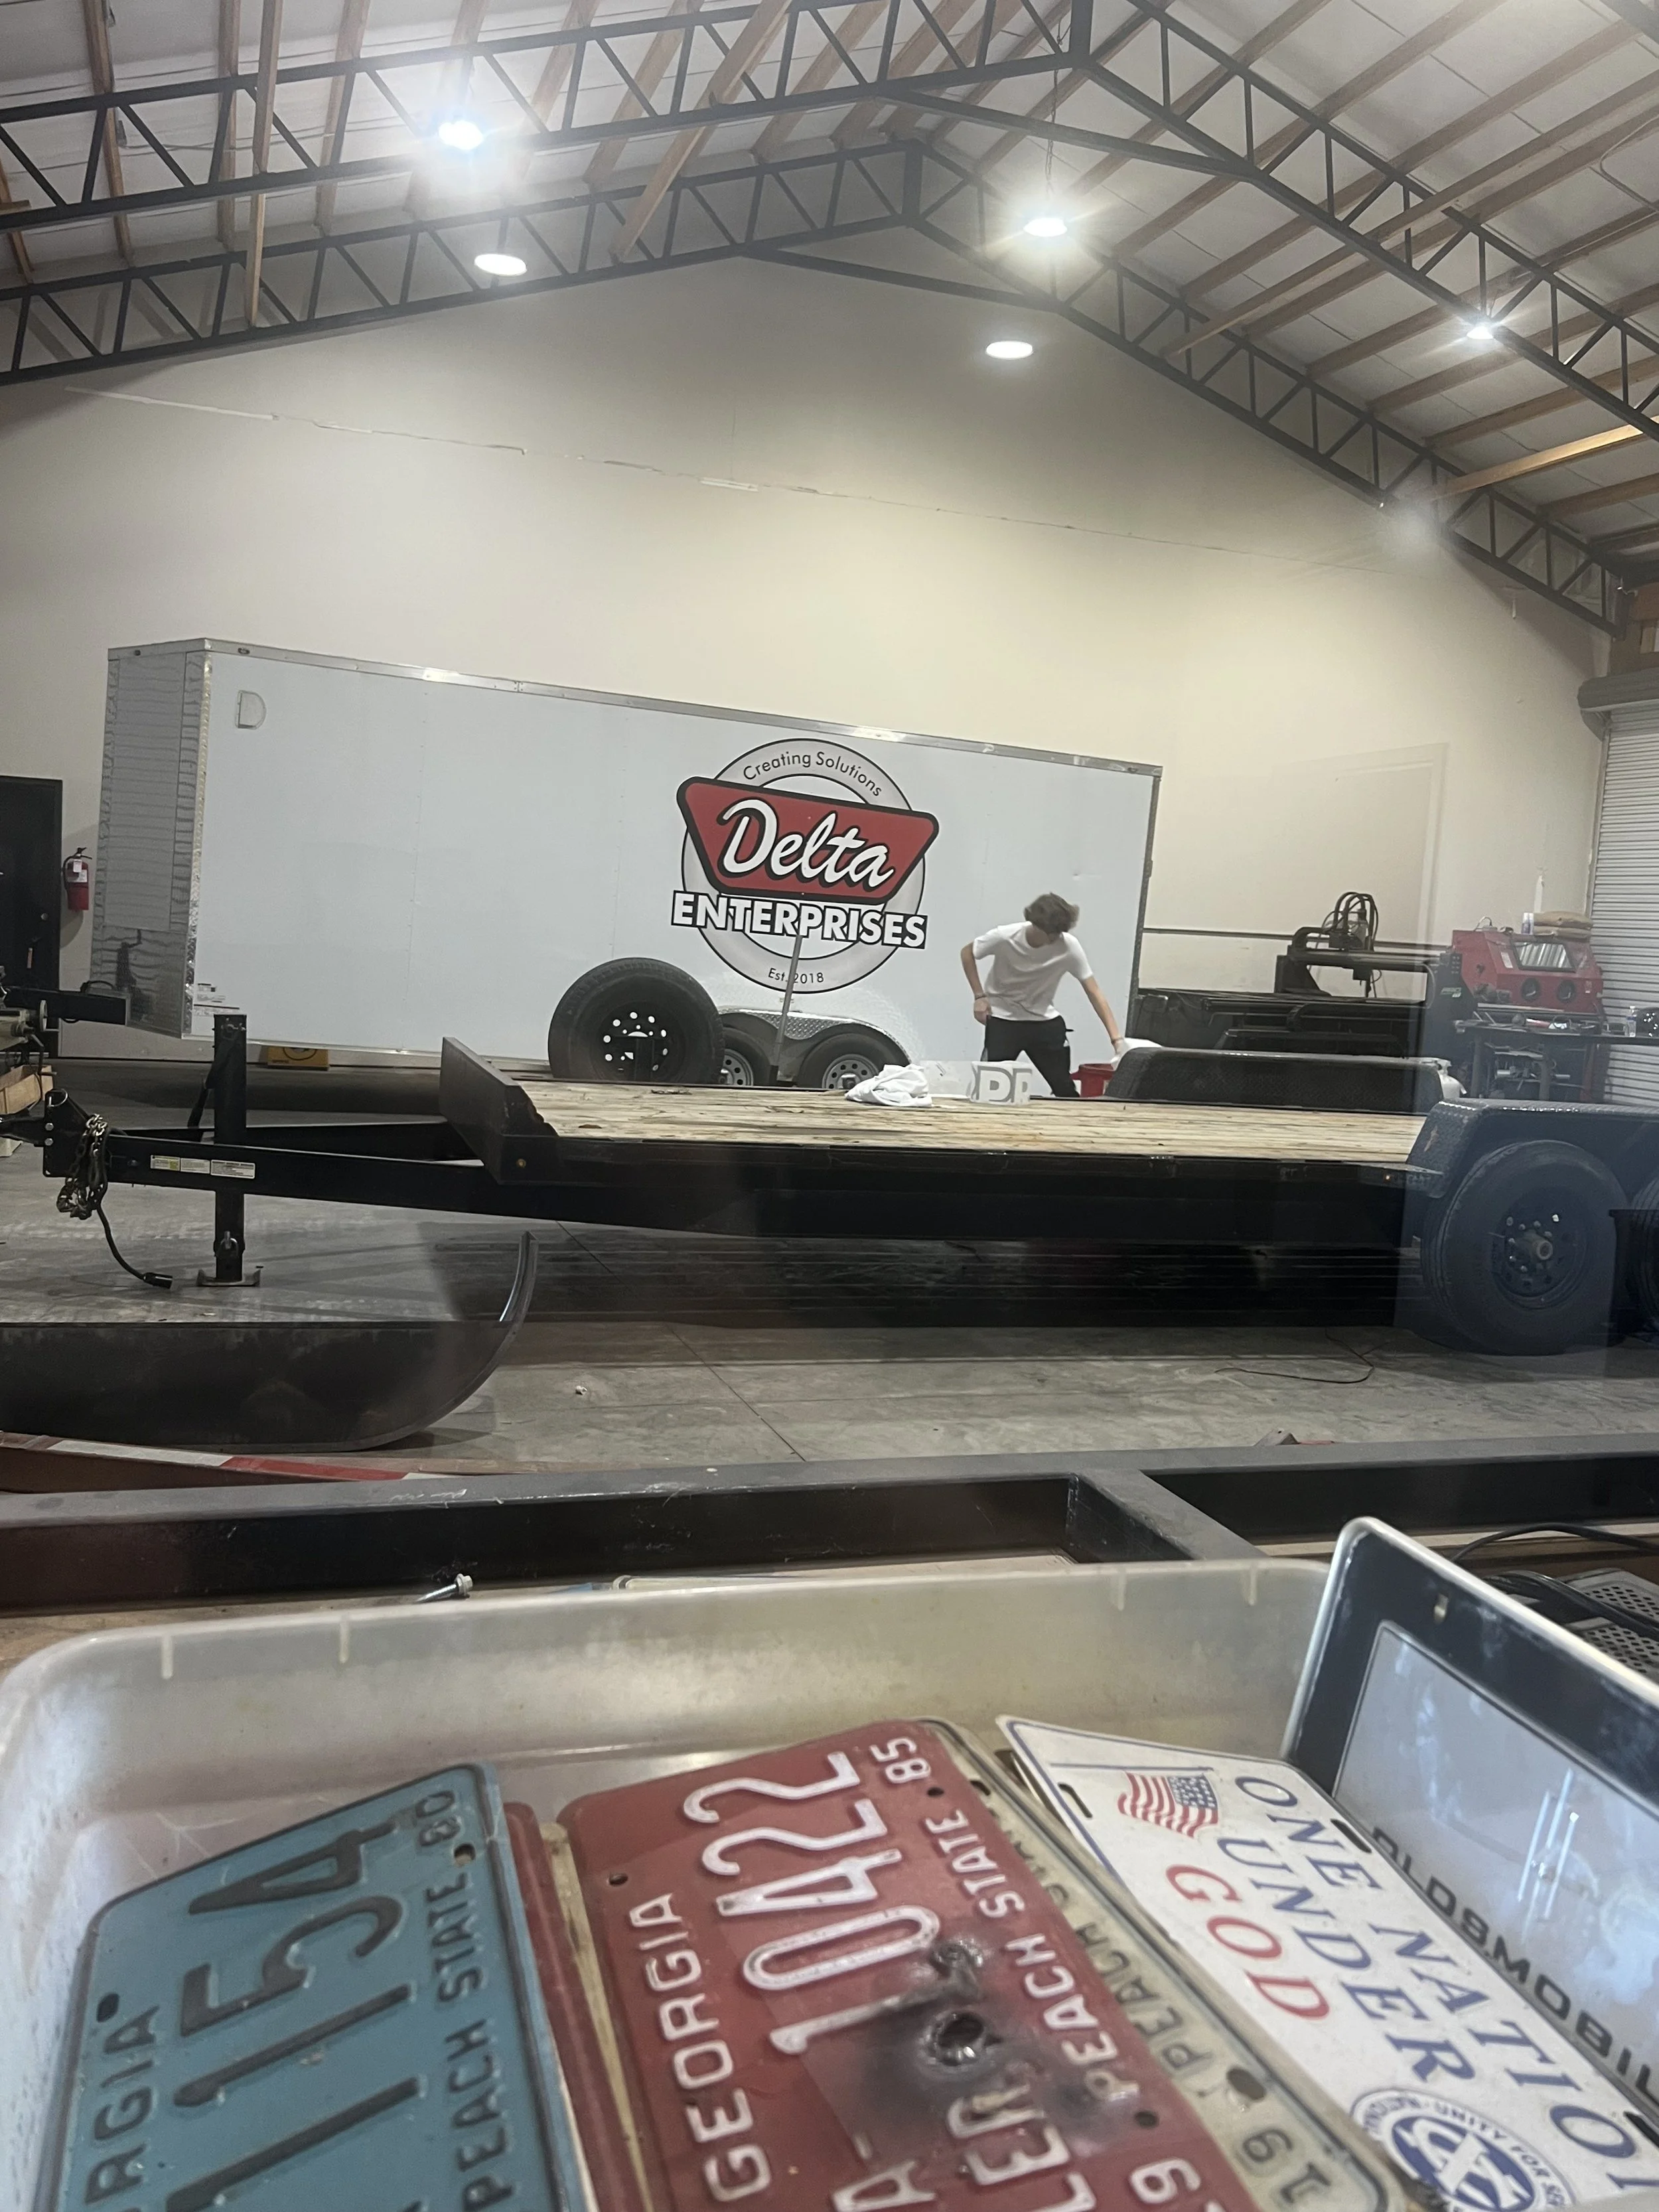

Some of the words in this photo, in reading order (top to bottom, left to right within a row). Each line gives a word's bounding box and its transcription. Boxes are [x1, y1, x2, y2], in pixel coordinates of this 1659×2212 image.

[743, 751, 811, 780] Creating
[815, 751, 882, 797] Solutions
[717, 798, 895, 893] Delta
[671, 890, 928, 949] ENTERPRISES
[869, 1736, 931, 1785] 85
[925, 1808, 1025, 1919] STATE
[1235, 1775, 1382, 1891] ONE
[425, 1873, 488, 2005] STATE
[683, 1751, 942, 2055] 10422
[1165, 1864, 1331, 2020] GOD
[1217, 1838, 1476, 2083] UNDER
[628, 1892, 772, 2202] GEORGIA
[1005, 1932, 1140, 2102] PEACH
[78, 2004, 161, 2212] RGIA
[445, 2018, 515, 2212] PEACH
[1242, 2128, 1332, 2205] 19
